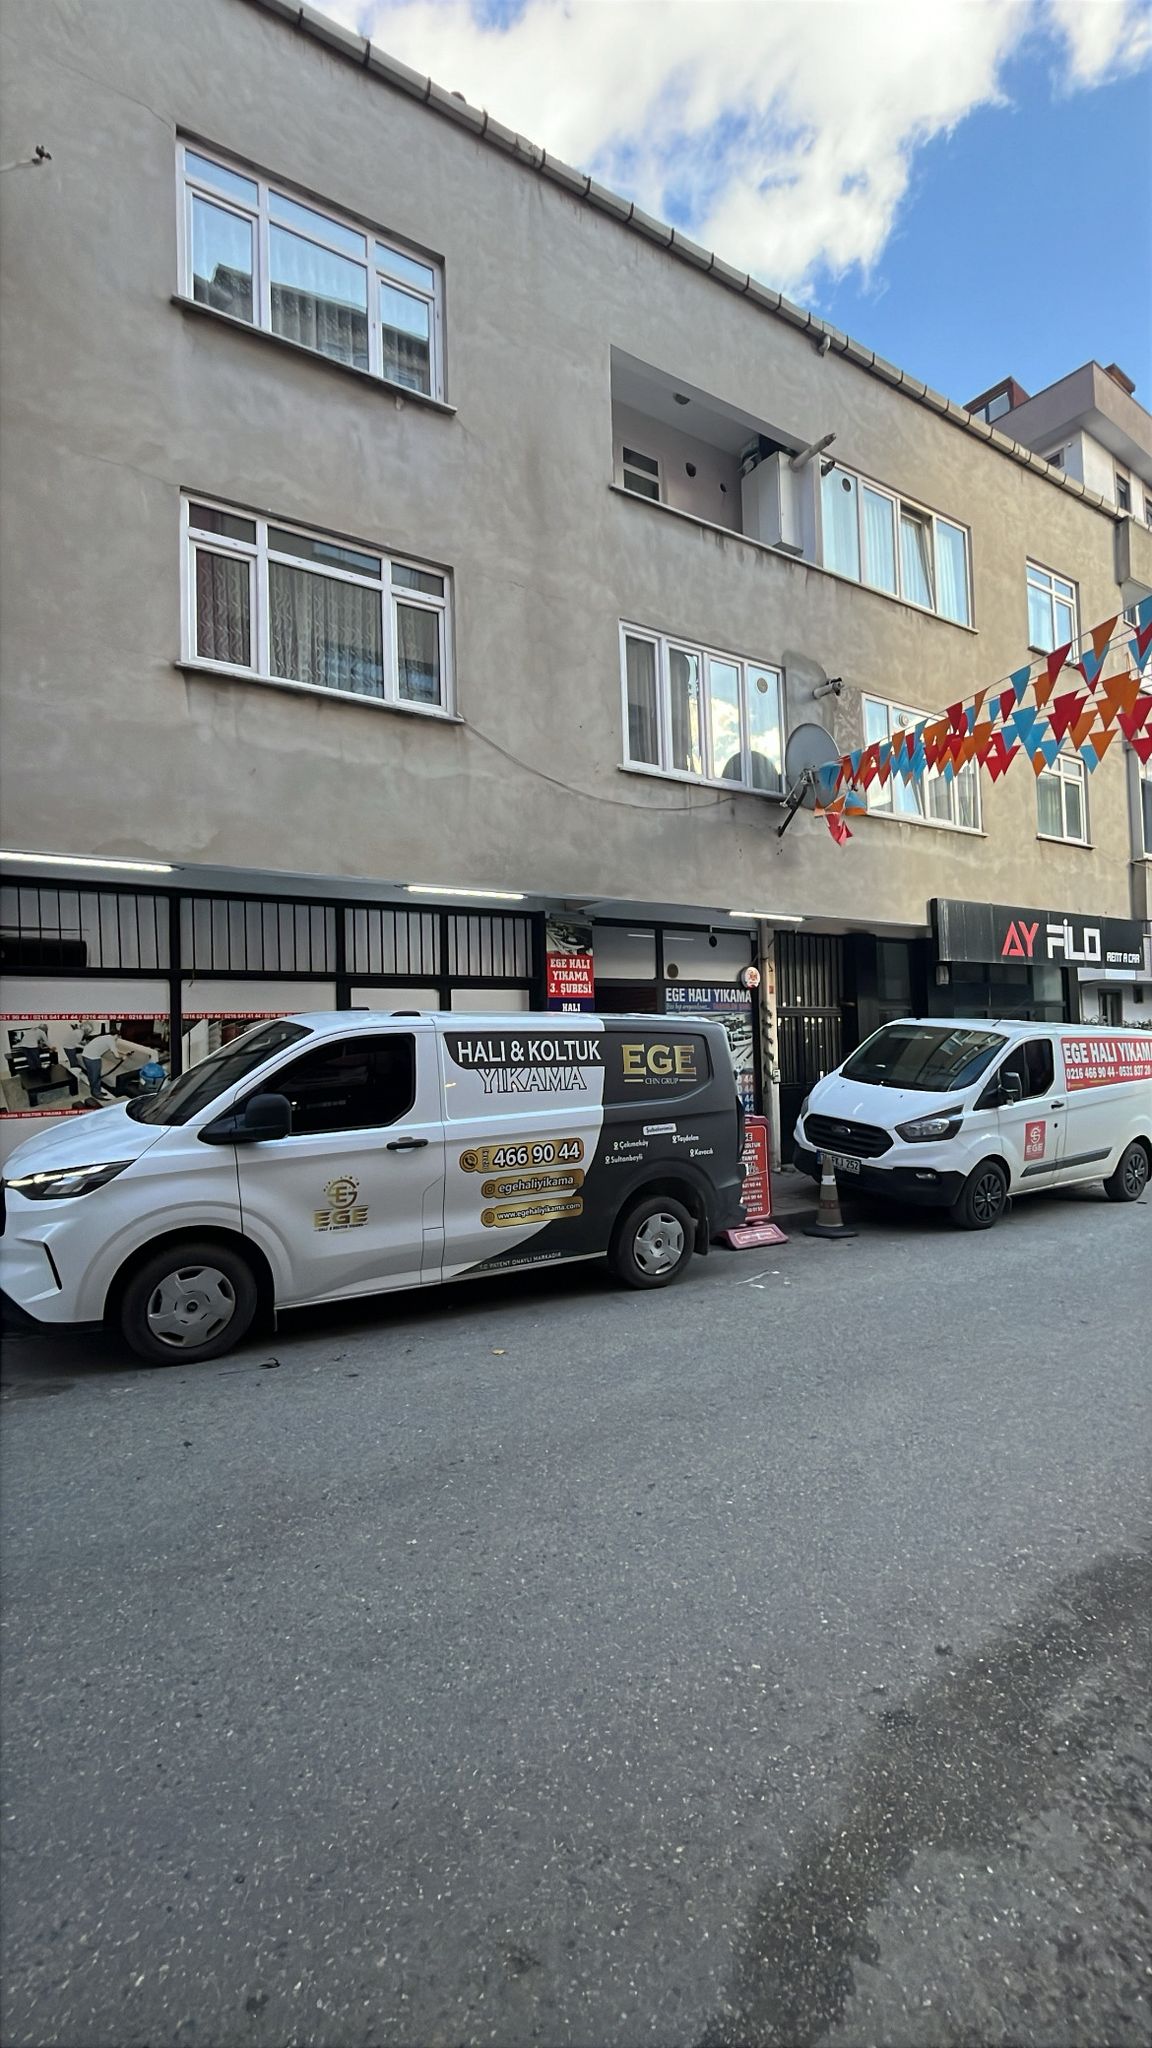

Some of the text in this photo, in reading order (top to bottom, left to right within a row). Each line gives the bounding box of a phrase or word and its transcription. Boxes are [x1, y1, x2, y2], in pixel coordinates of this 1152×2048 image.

[1001, 921, 1039, 957] AY
[550, 959, 590, 969] EGE HALI
[1106, 952, 1141, 964] RENT A CAR
[552, 971, 589, 981] YIKAMA
[549, 982, 592, 995] 3. ŞUBESİ
[665, 988, 752, 1003] EGE HALI YIKAMA
[562, 1003, 580, 1012] HALI
[457, 1040, 602, 1063] HALI & KOLTUK
[621, 1043, 697, 1075] EGE
[1062, 1042, 1152, 1064] EGE HALI YIKAM
[476, 1067, 587, 1093] YIKAMA
[1066, 1068, 1084, 1080] 0216
[1084, 1067, 1098, 1078] 466
[1098, 1066, 1106, 1078] 90
[1107, 1066, 1115, 1077] 44
[661, 1077, 679, 1085] GRUP
[493, 1147, 528, 1167] 466
[532, 1144, 555, 1163] 90
[558, 1141, 580, 1159] 44
[1026, 1143, 1043, 1153] EGE
[846, 1159, 859, 1171] 252
[498, 1176, 574, 1195] egehaliyikama
[313, 1207, 369, 1228] EGE
[497, 1203, 580, 1219] www.egehaliyikama.com
